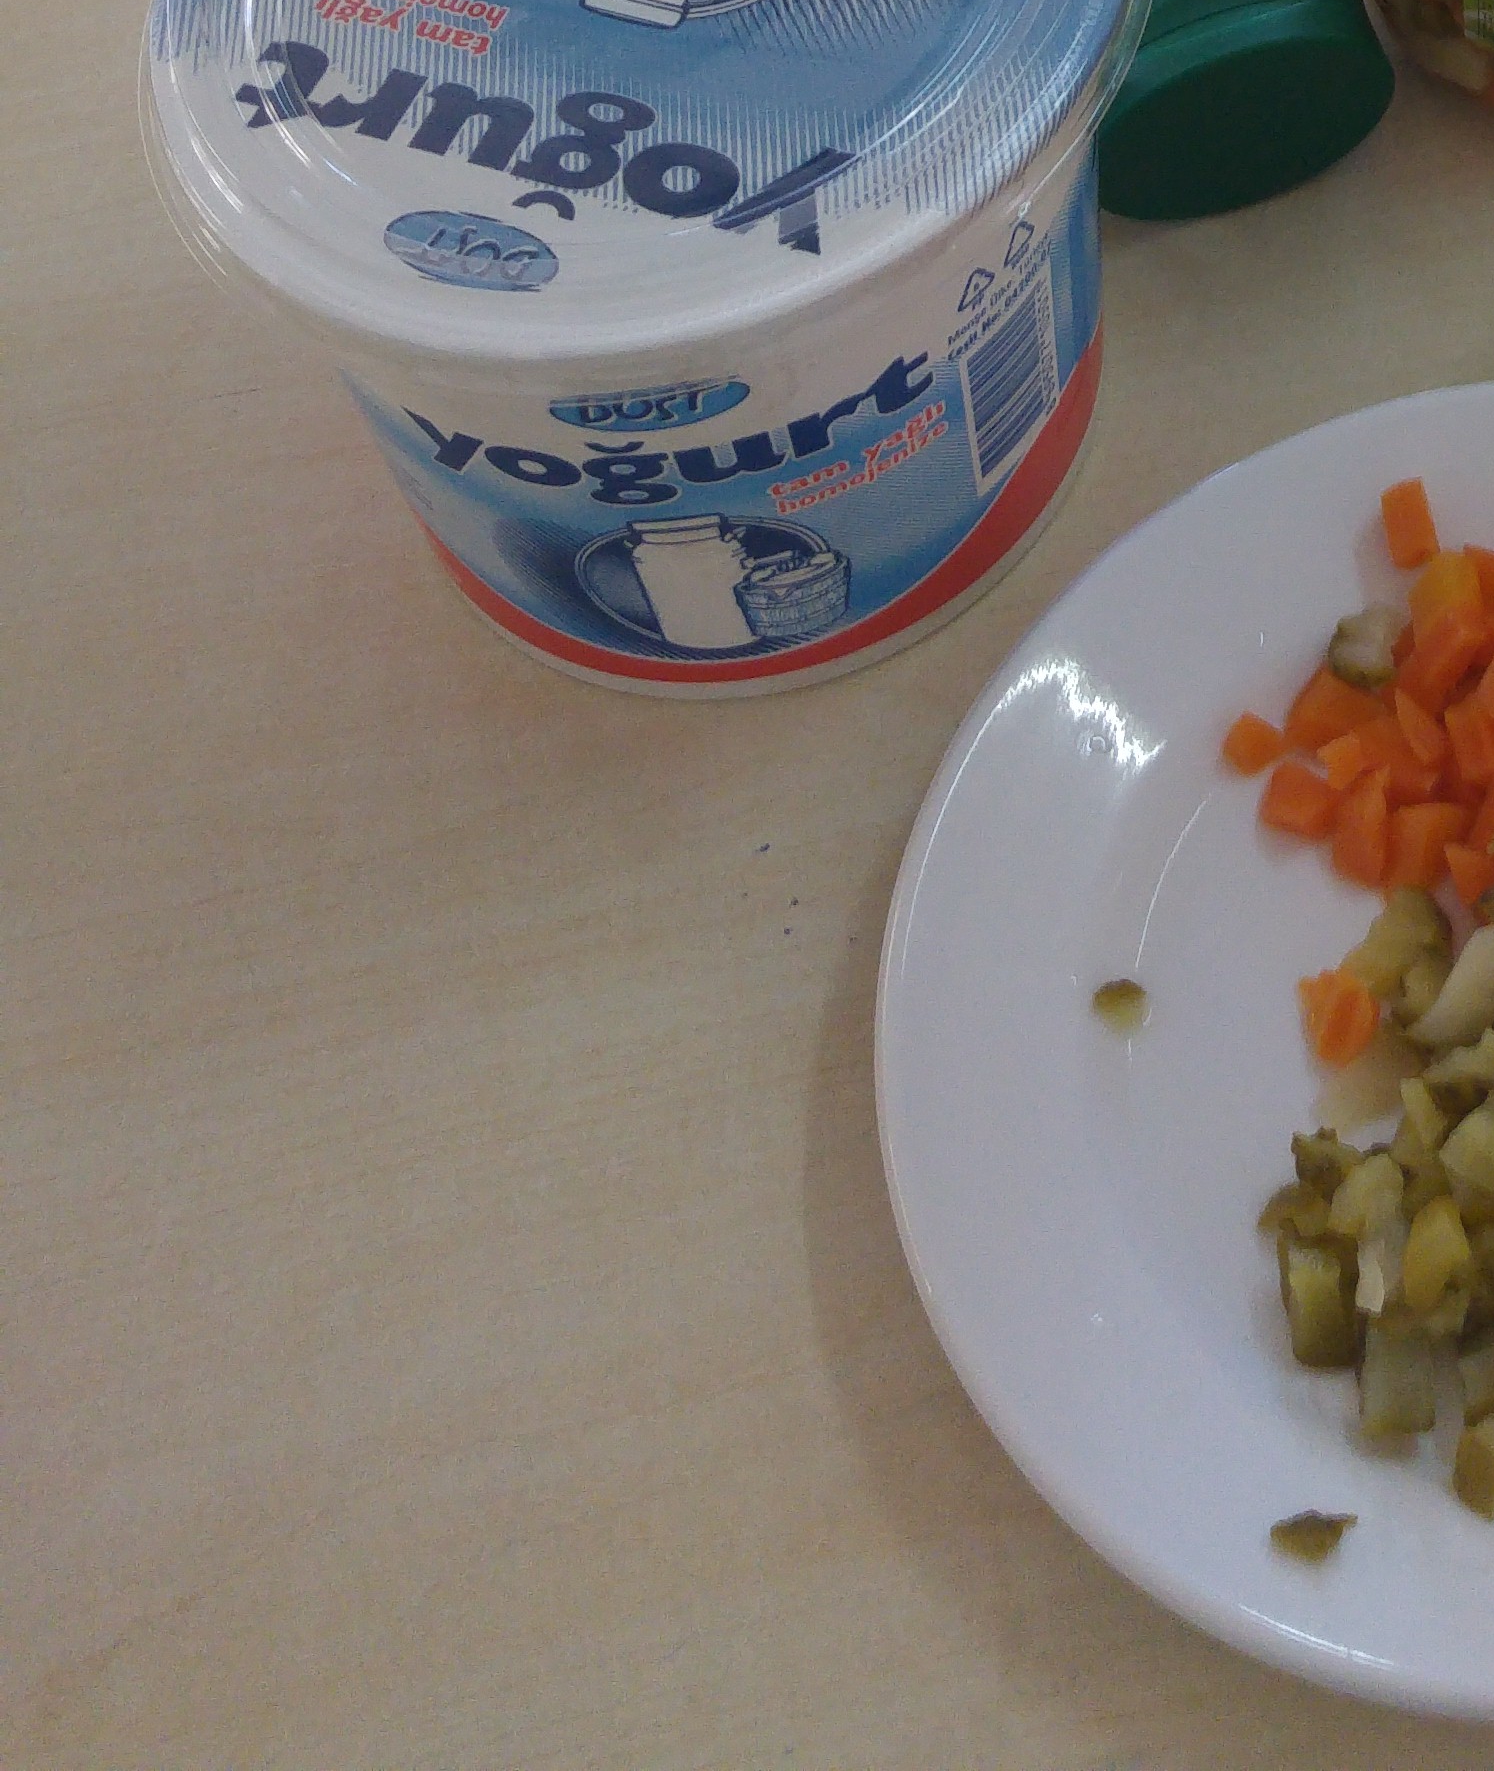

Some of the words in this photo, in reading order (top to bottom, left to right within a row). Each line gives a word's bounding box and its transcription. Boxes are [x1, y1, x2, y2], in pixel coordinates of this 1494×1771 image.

[416, 19, 491, 55] tam
[233, 40, 860, 255] Yoğurt
[401, 351, 933, 504] Yoğurt
[777, 422, 949, 514] homojenize
[769, 461, 849, 498] tam
